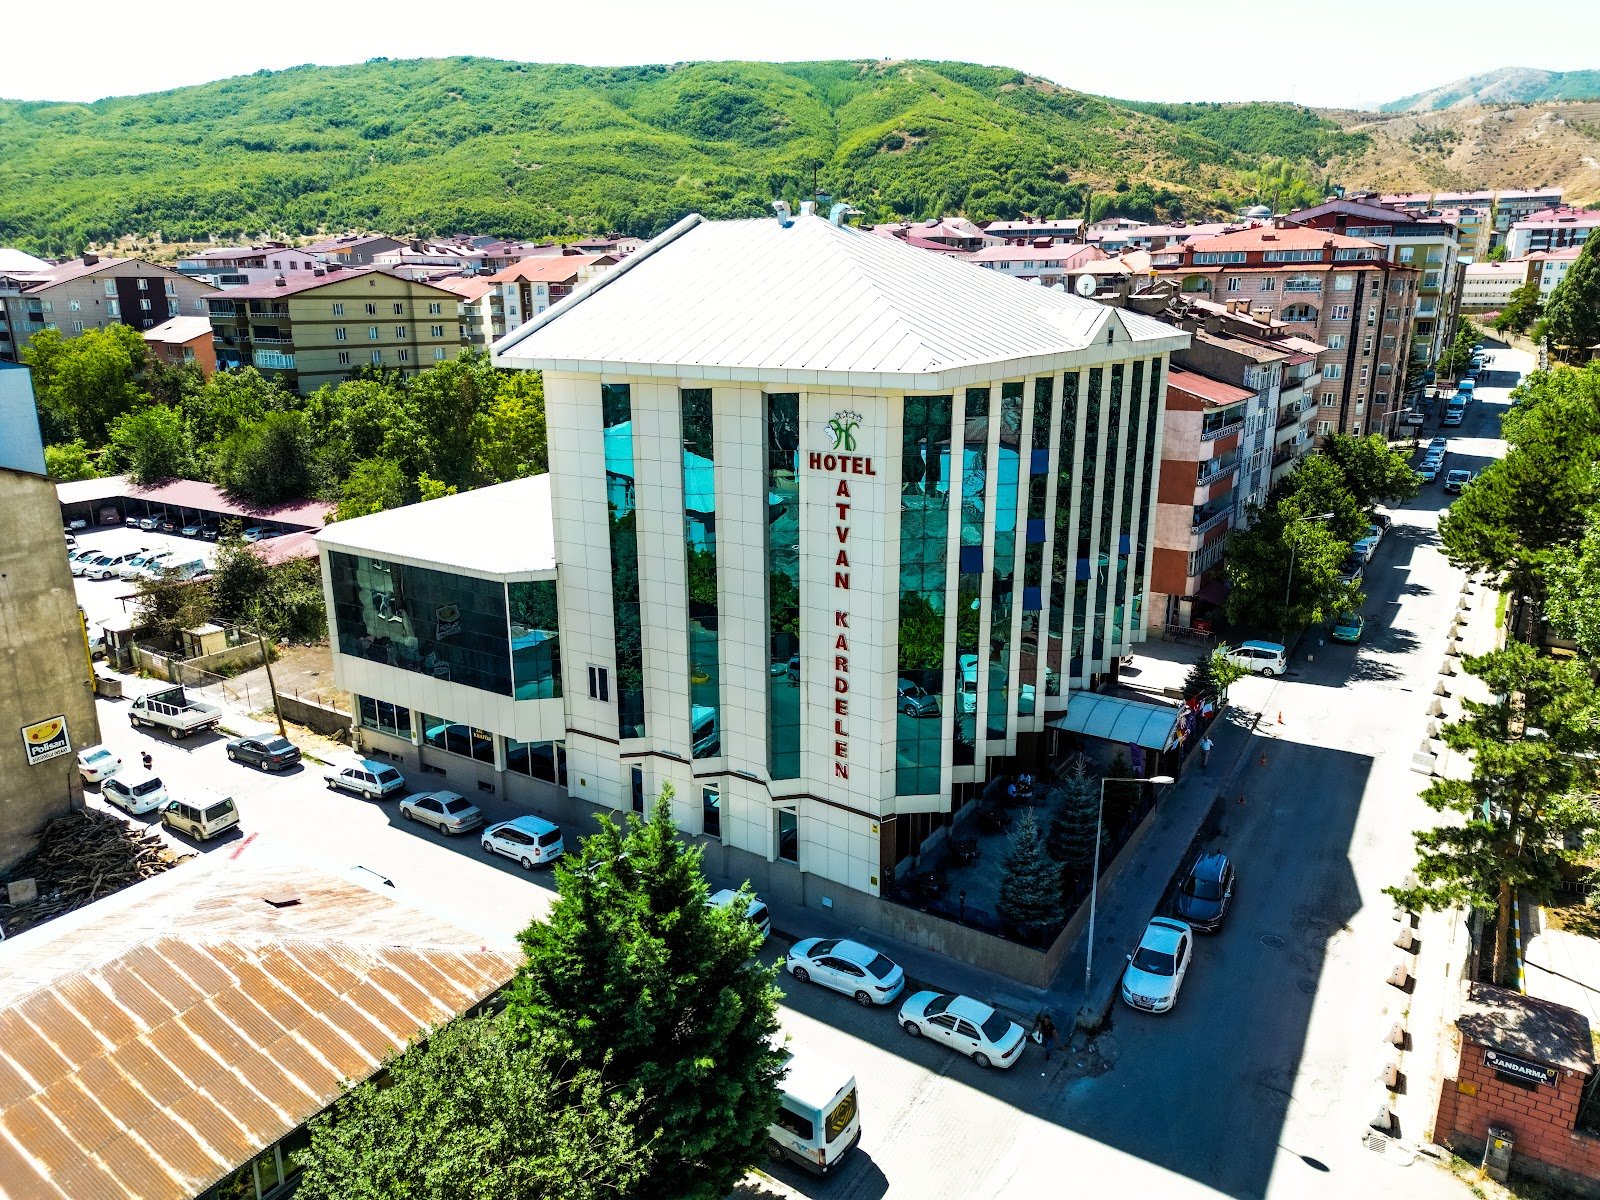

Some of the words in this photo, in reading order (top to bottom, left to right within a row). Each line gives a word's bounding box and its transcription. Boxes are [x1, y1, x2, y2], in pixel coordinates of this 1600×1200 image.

[809, 452, 876, 476] HOTEL
[835, 610, 850, 780] KARDELEN
[31, 740, 64, 755] Polisan
[1492, 1058, 1548, 1081] JANDARMA
